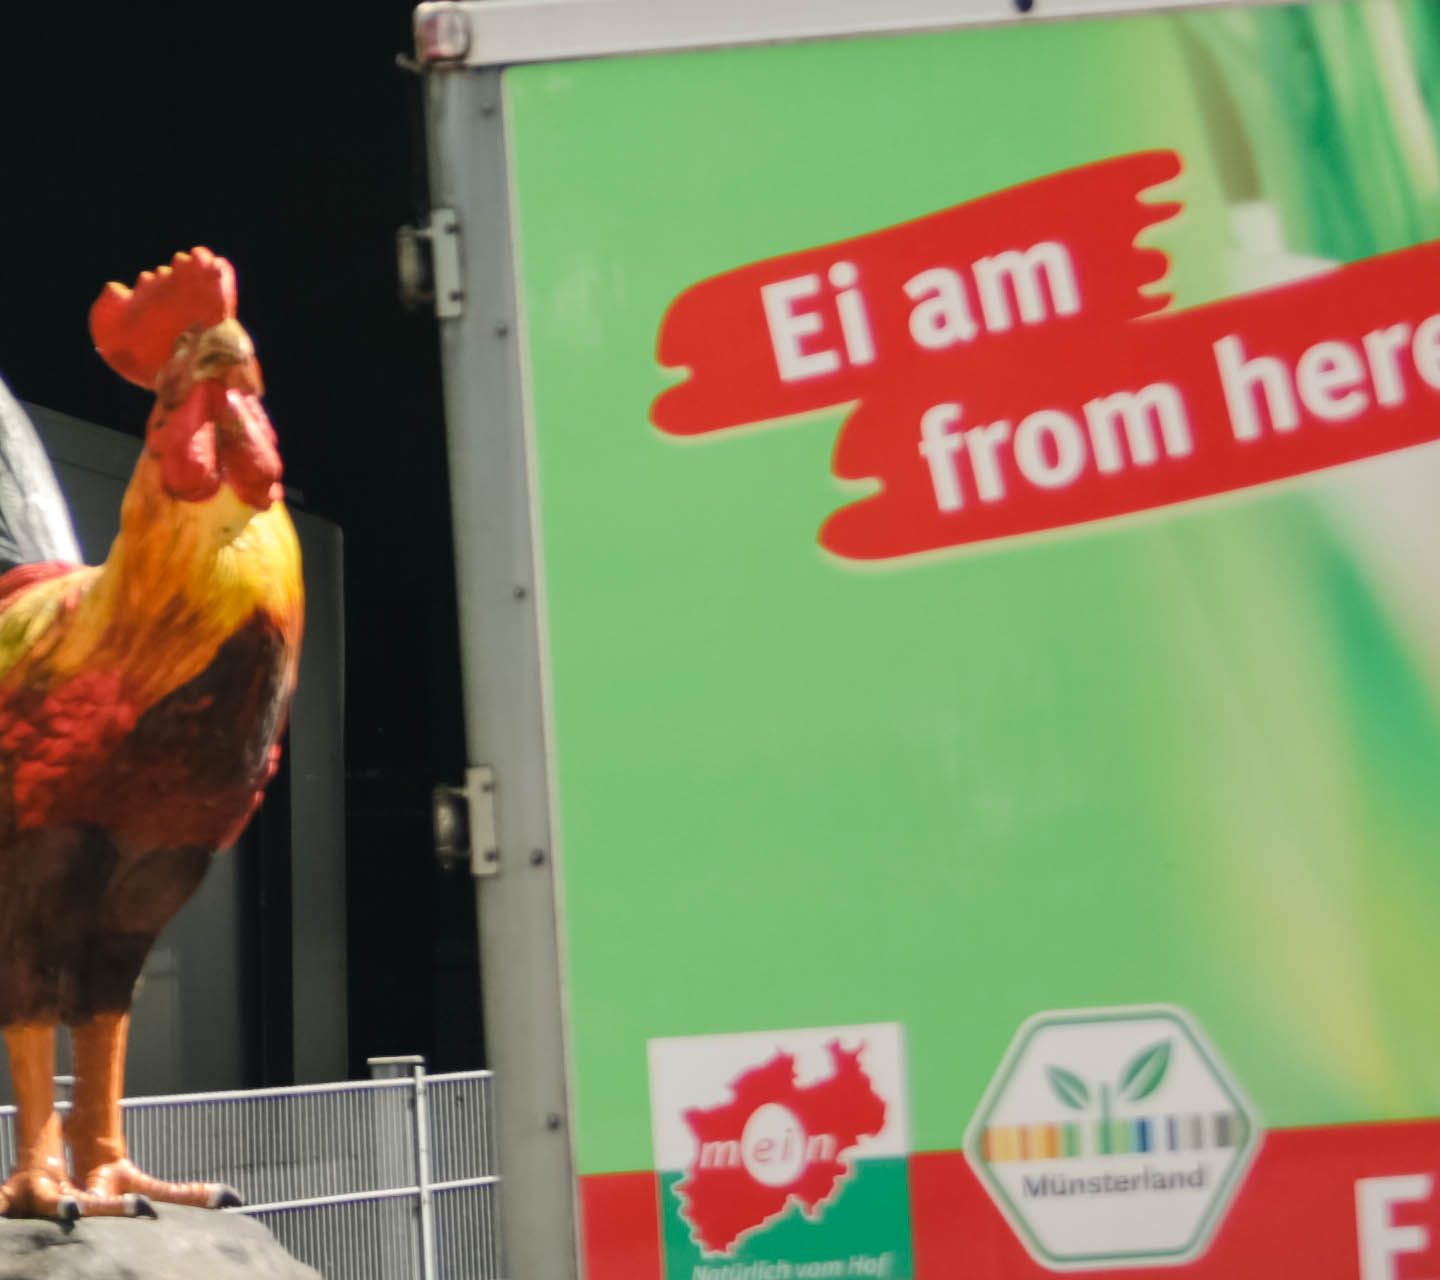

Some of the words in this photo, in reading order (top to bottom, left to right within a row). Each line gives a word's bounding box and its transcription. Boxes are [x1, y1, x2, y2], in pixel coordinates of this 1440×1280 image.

[760, 260, 876, 383] Ei
[902, 239, 1082, 351] am
[918, 380, 1193, 514] from
[700, 1128, 836, 1169] mein
[1023, 1165, 1207, 1199] Münsterland
[796, 1260, 843, 1279] vom
[848, 1251, 894, 1279] Hof
